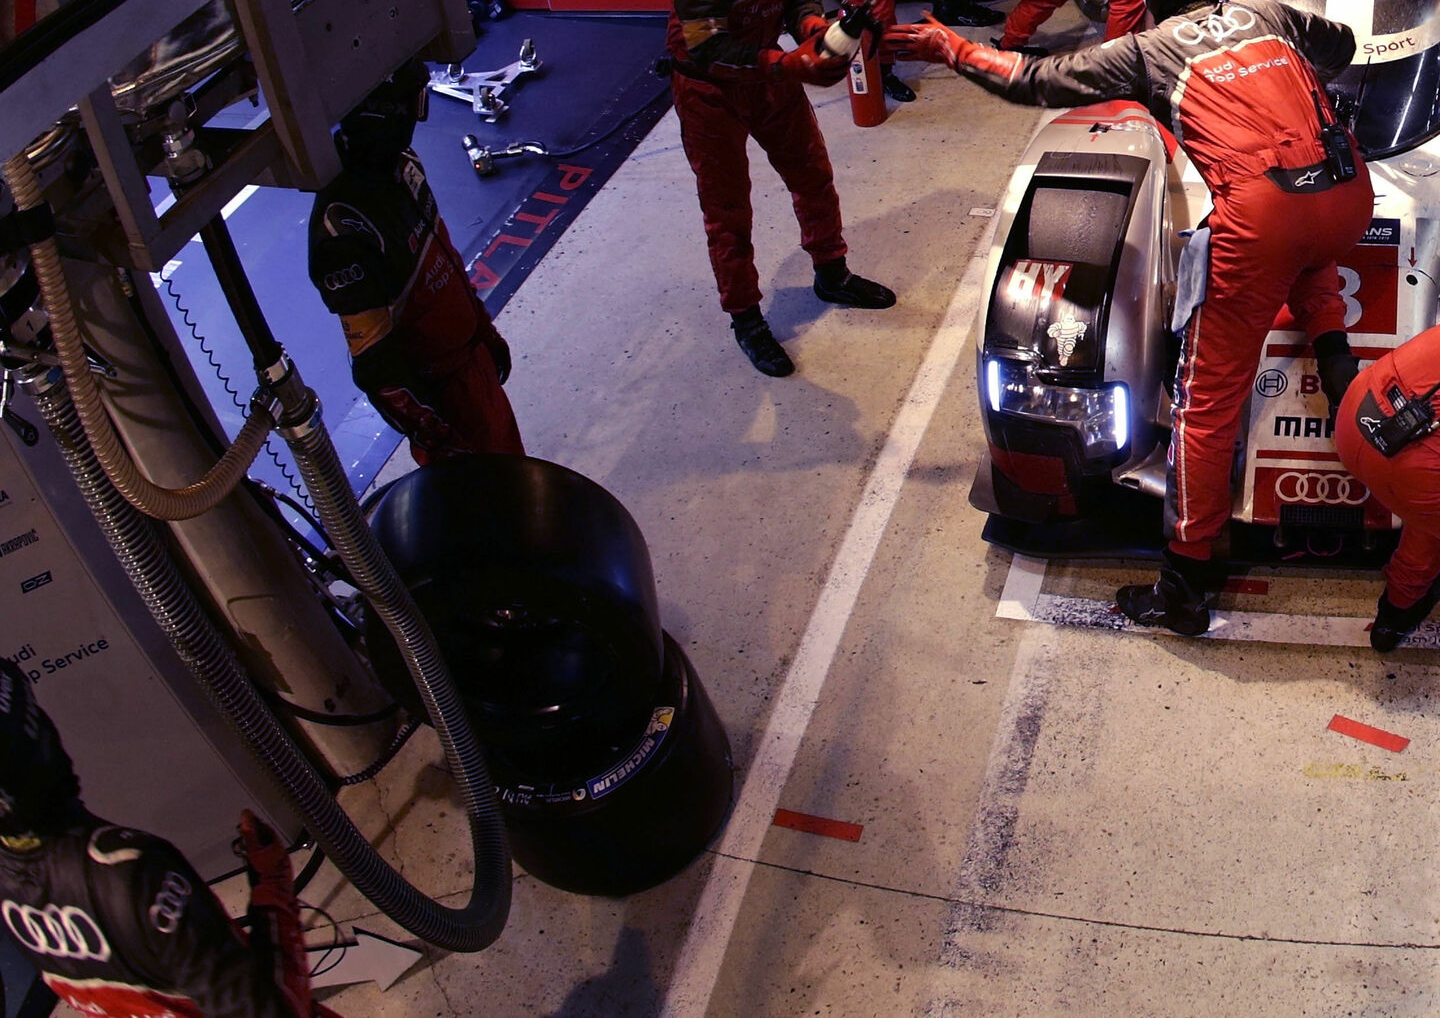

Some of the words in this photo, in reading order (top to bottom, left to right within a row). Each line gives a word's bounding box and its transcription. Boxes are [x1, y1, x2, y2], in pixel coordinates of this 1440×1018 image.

[1363, 34, 1416, 56] Sport
[1203, 60, 1236, 75] Audi
[1204, 71, 1236, 85] Top
[1239, 56, 1290, 78] Service
[1007, 261, 1070, 301] HY
[9, 643, 37, 666] udi
[42, 638, 110, 675] Service
[593, 737, 656, 794] MICHELIN
